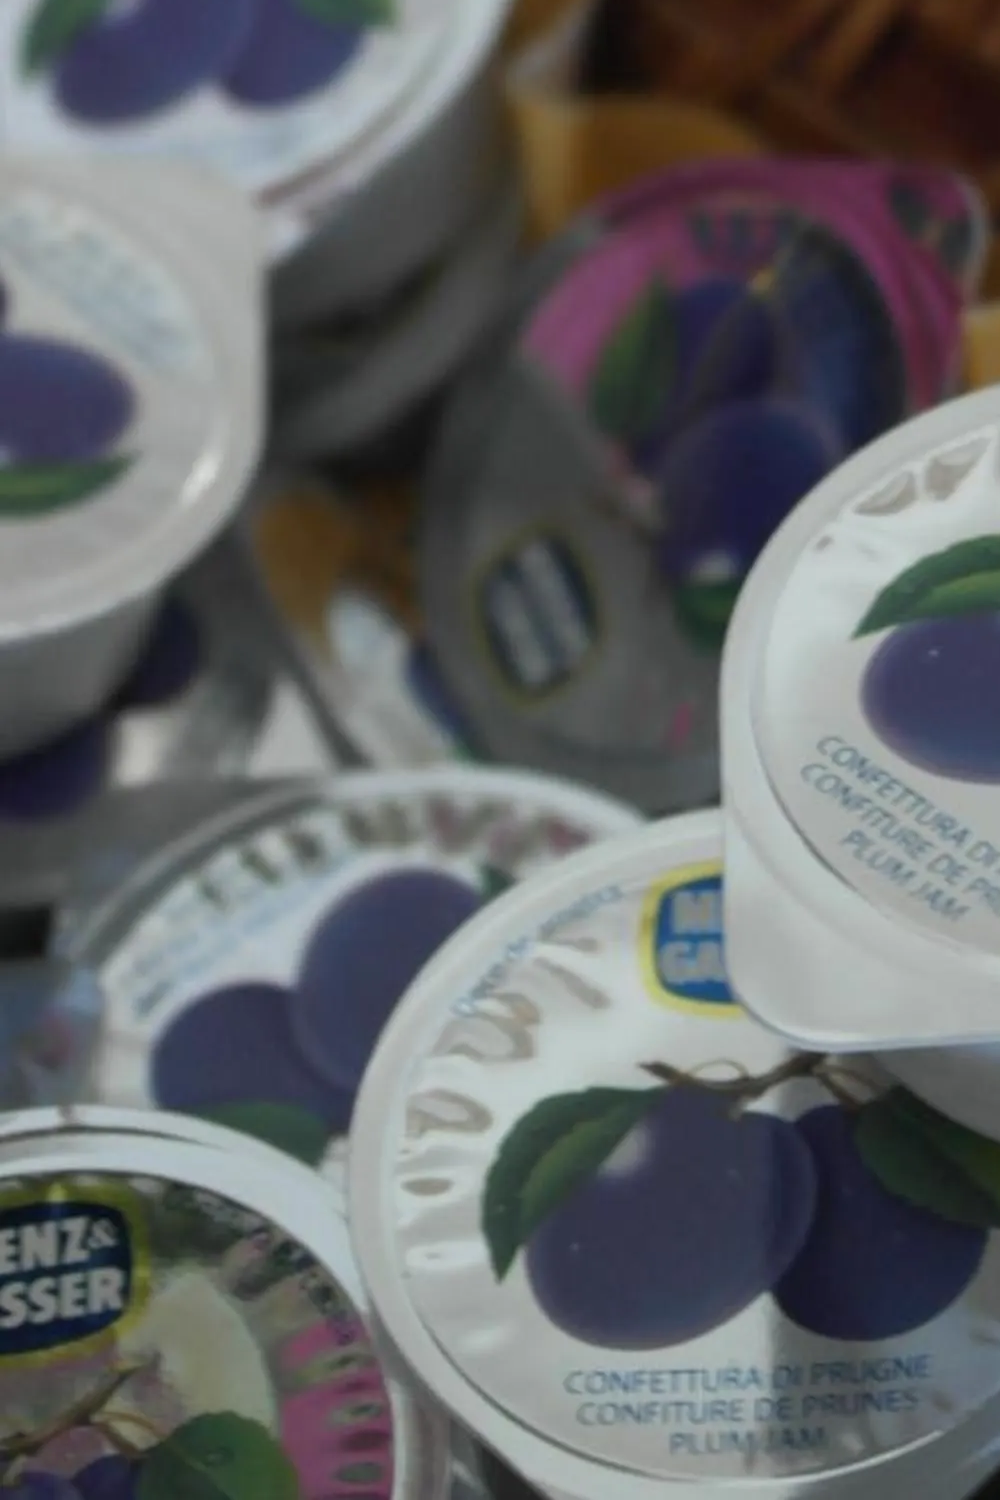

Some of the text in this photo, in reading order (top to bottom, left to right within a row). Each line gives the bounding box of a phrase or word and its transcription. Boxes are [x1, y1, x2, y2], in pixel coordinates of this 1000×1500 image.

[815, 735, 973, 847] CONFETTURA
[800, 762, 936, 861] CONFITURE
[926, 853, 969, 885] DE
[840, 830, 970, 921] PLUM JAM
[0, 1215, 118, 1276] ENZ&
[0, 1266, 125, 1329] SSER
[562, 1354, 934, 1395] CONFETTURA DI PRUGNE
[576, 1389, 921, 1427] CONFITURE DE PRUNES
[669, 1430, 757, 1456] PLUM
